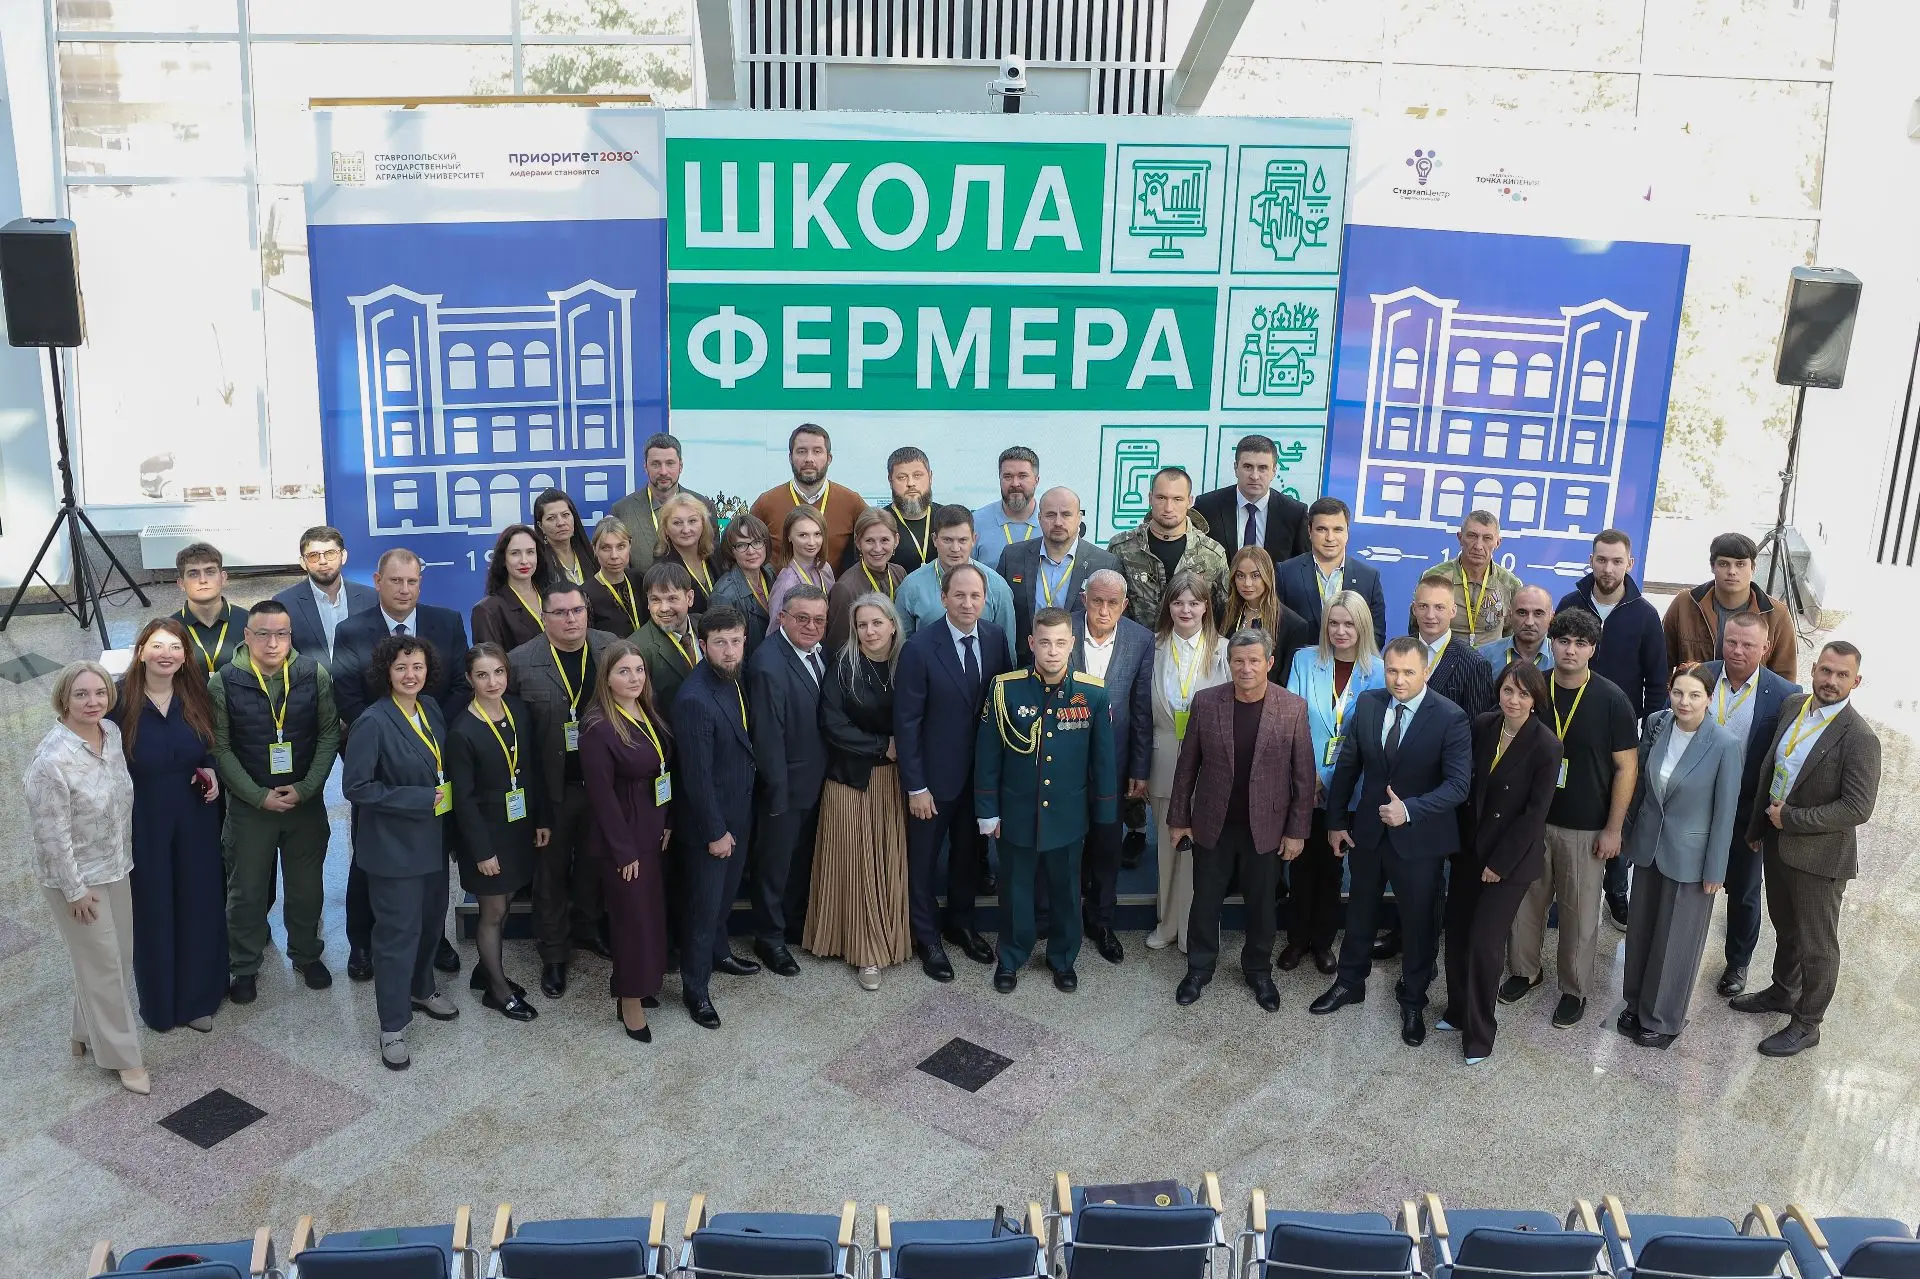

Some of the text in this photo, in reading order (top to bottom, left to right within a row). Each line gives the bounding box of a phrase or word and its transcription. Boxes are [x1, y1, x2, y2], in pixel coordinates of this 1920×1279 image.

[374, 152, 457, 162] СТАВРОПОЛЬСКИЙ
[375, 162, 462, 172] ГОСУДАРСТВЕННЫЙ
[375, 172, 485, 181] АГРАРНЫЙ УНИВЕРСИТЕТ
[510, 168, 600, 178] лидерами становятся
[685, 161, 1083, 252] ШКОЛА
[687, 305, 1193, 390] ФЕРМЕРА
